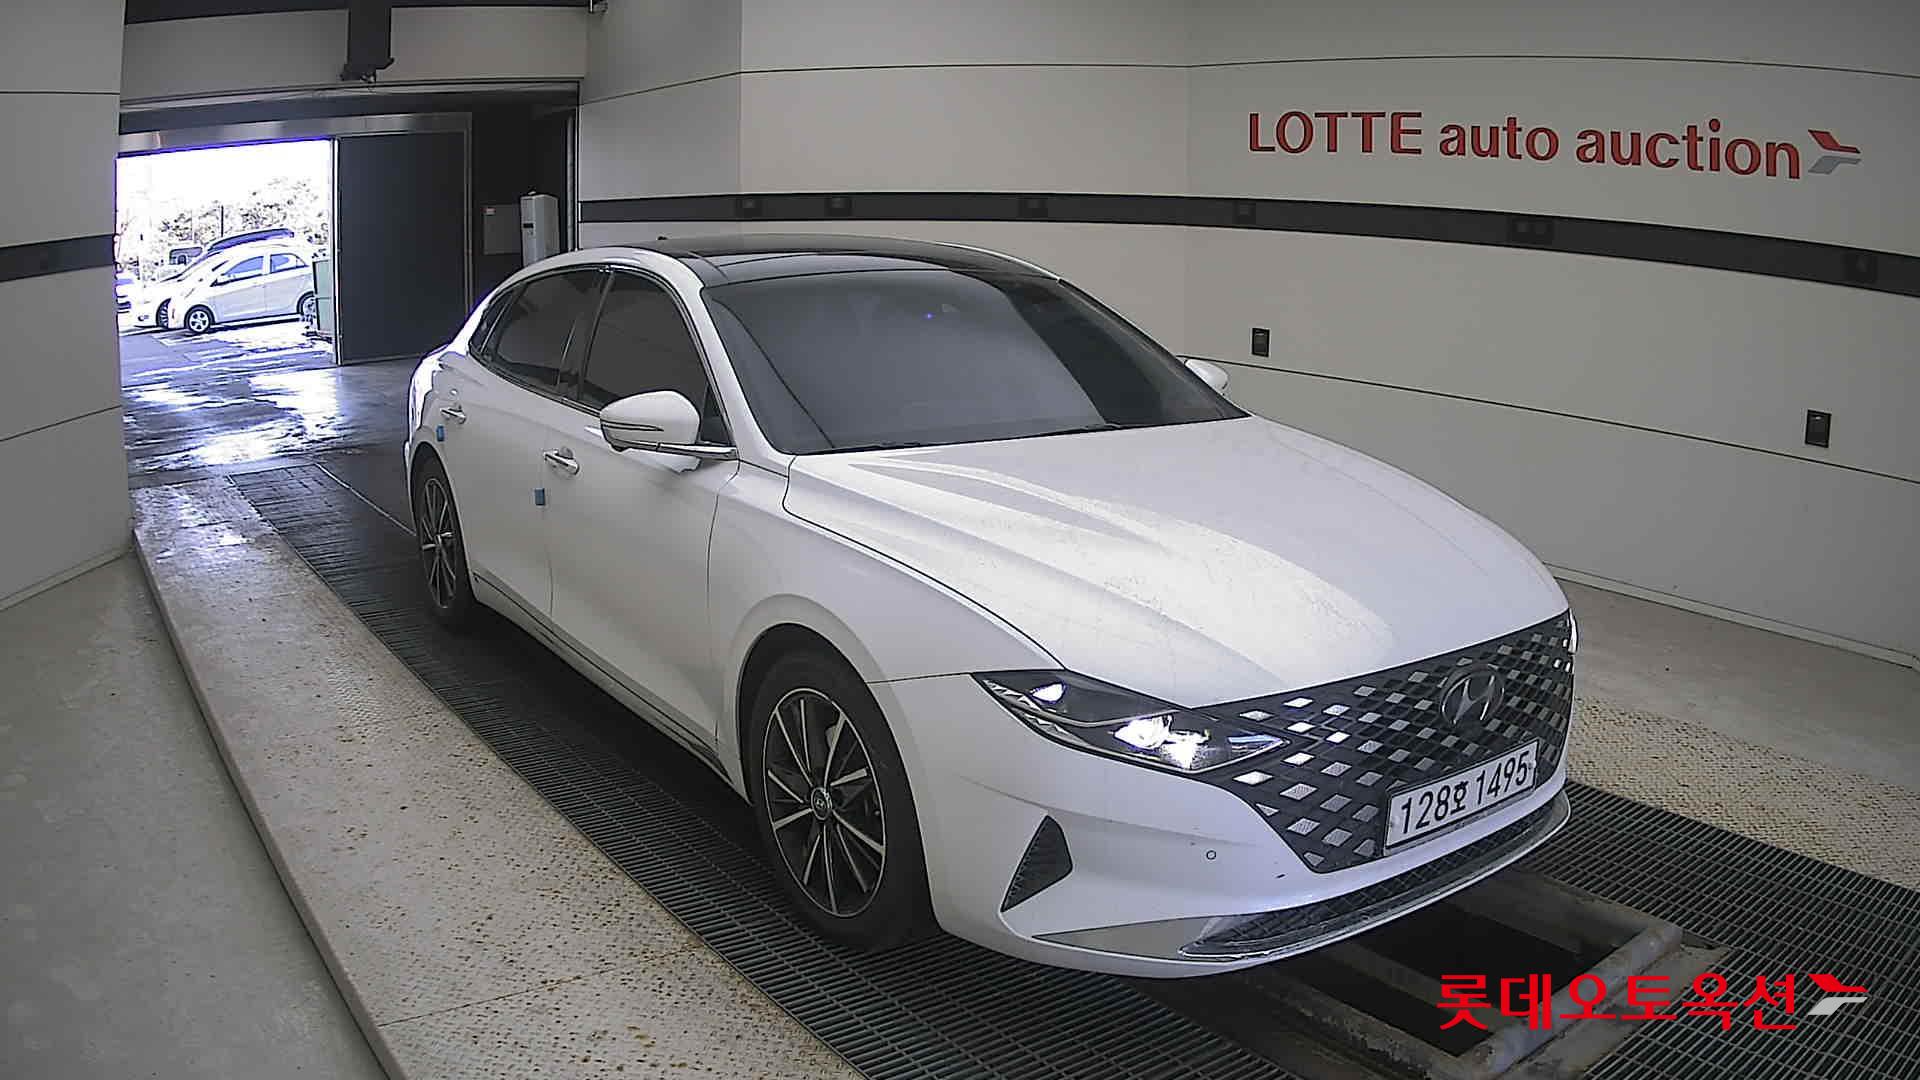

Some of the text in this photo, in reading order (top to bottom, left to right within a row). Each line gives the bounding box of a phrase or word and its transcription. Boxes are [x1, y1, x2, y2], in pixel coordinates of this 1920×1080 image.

[1248, 110, 1801, 180] LOTTE auto auction
[1401, 750, 1530, 834] 128호 1495
